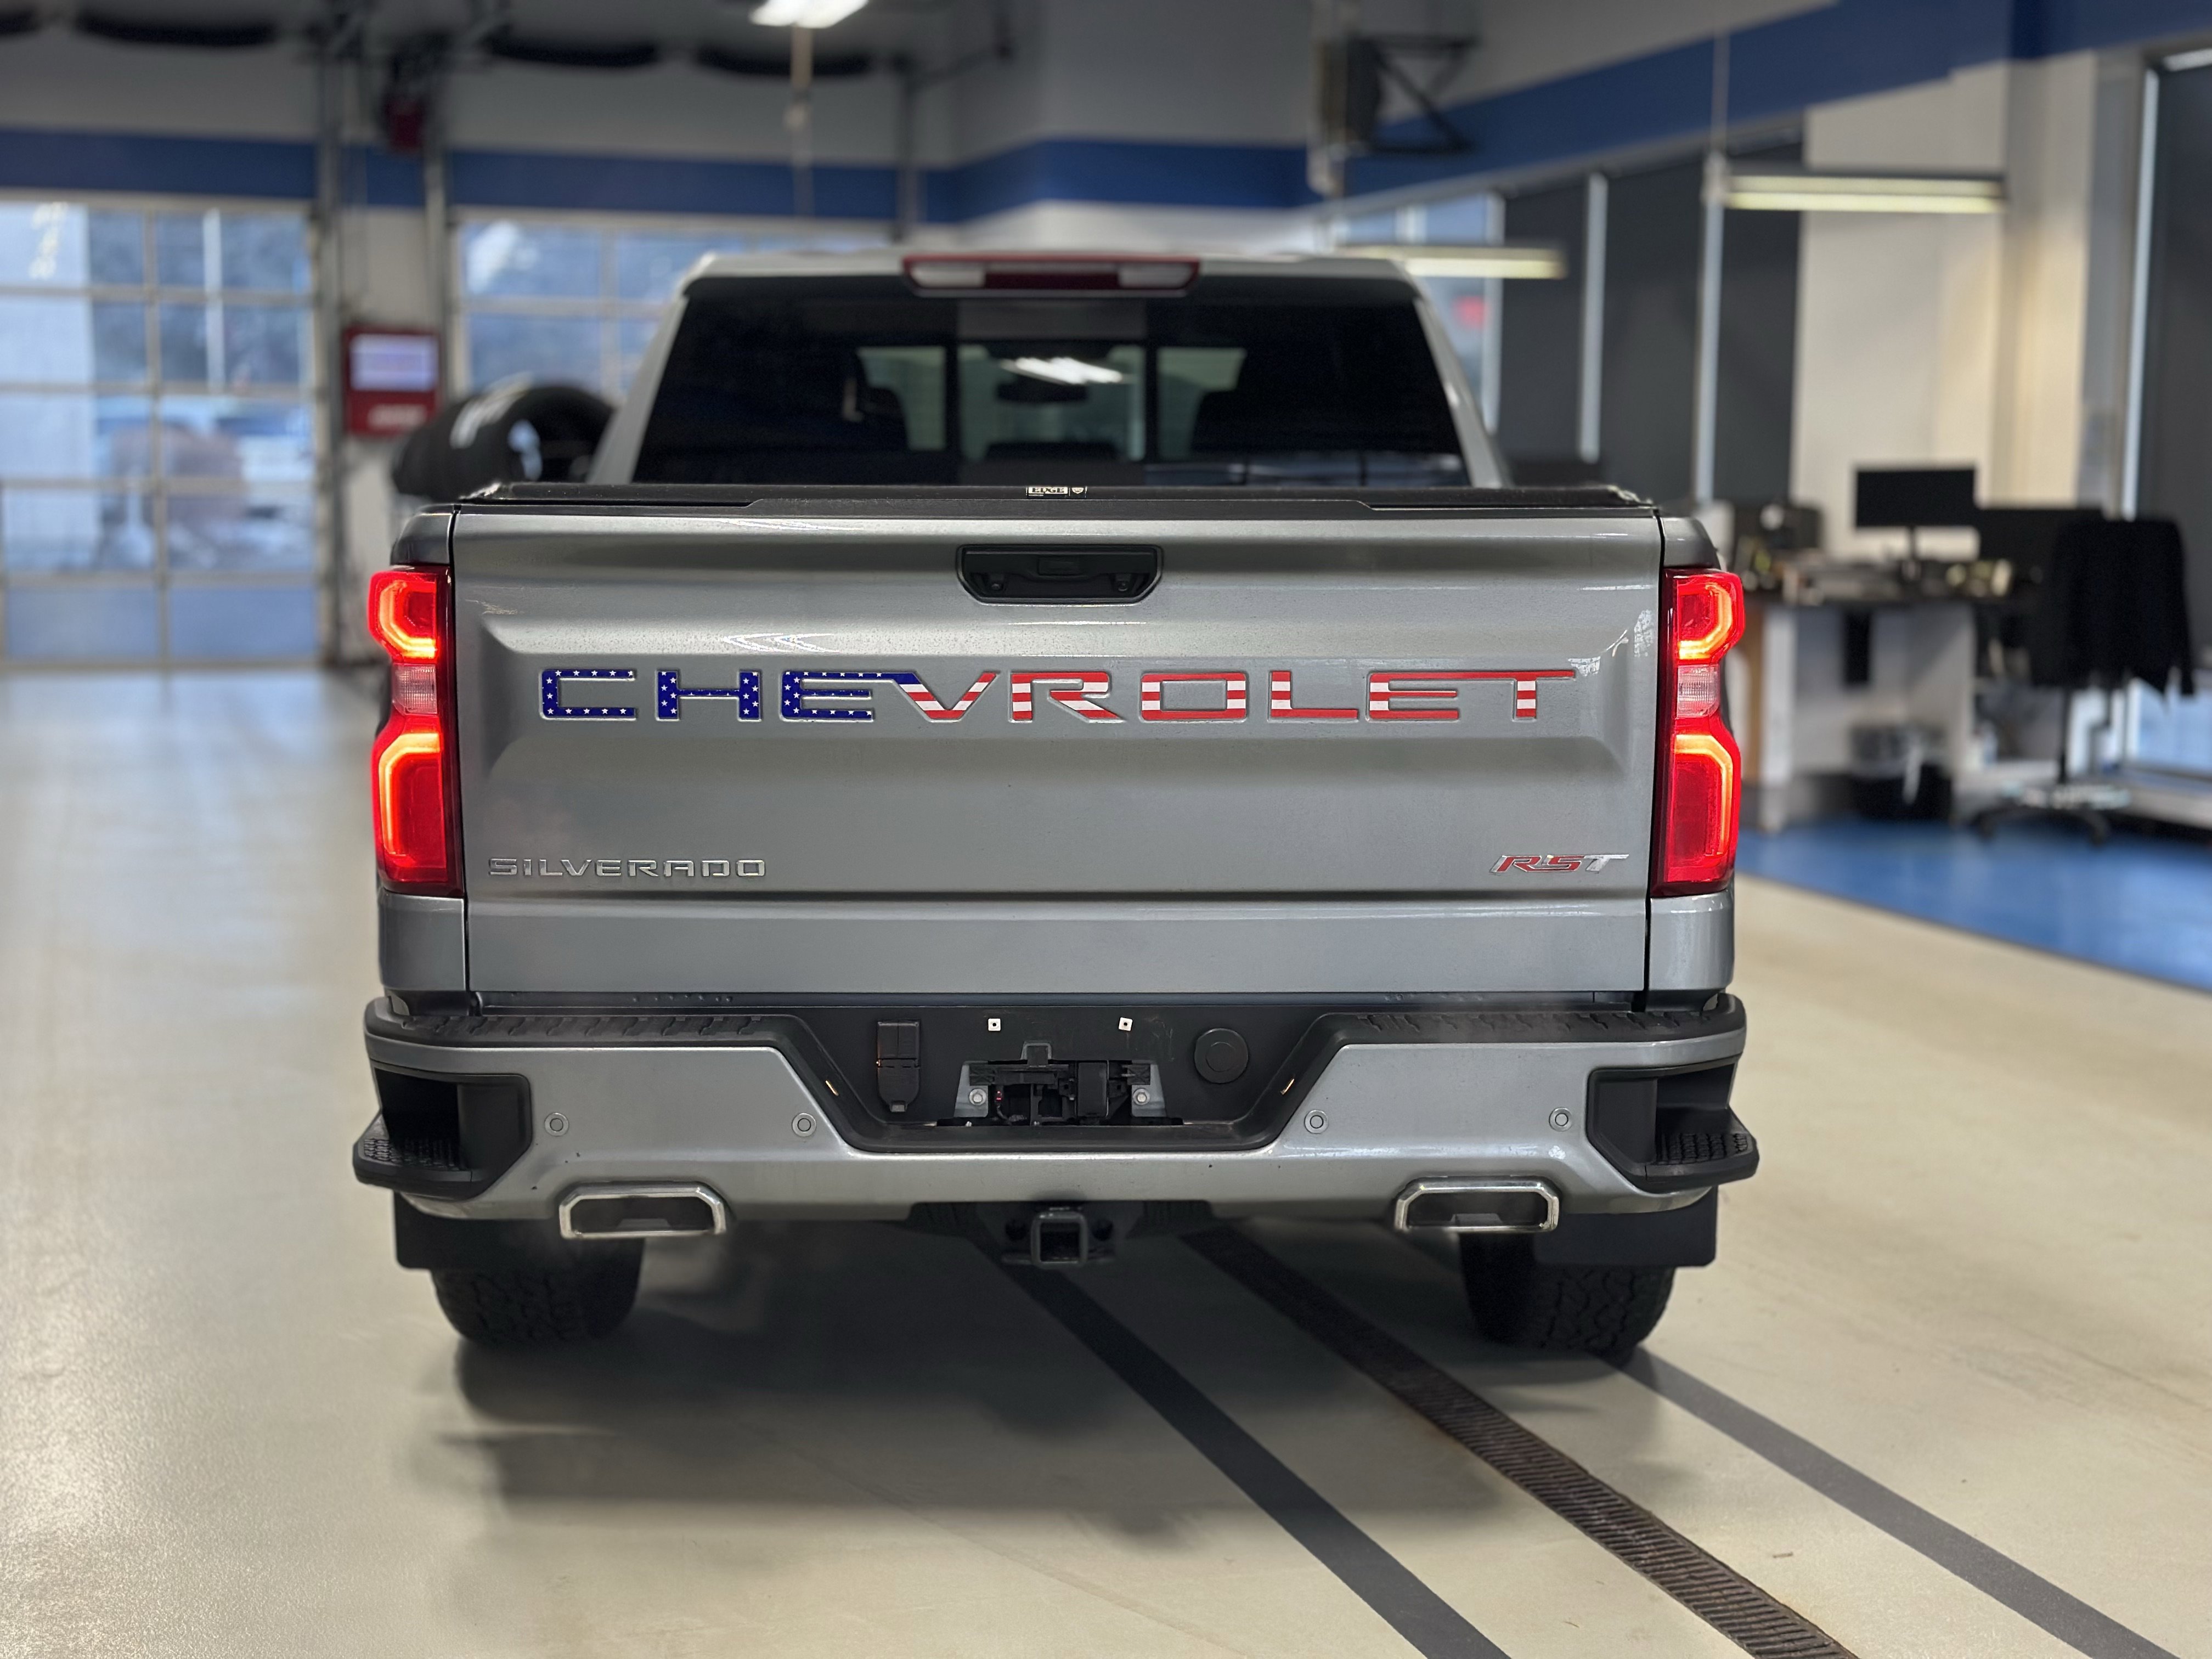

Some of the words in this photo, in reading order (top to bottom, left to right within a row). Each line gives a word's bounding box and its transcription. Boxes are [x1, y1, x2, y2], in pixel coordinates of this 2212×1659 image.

[541, 669, 1576, 722] CHEVROLET
[489, 859, 766, 877] SILVERADO
[1490, 854, 1629, 873] RST
